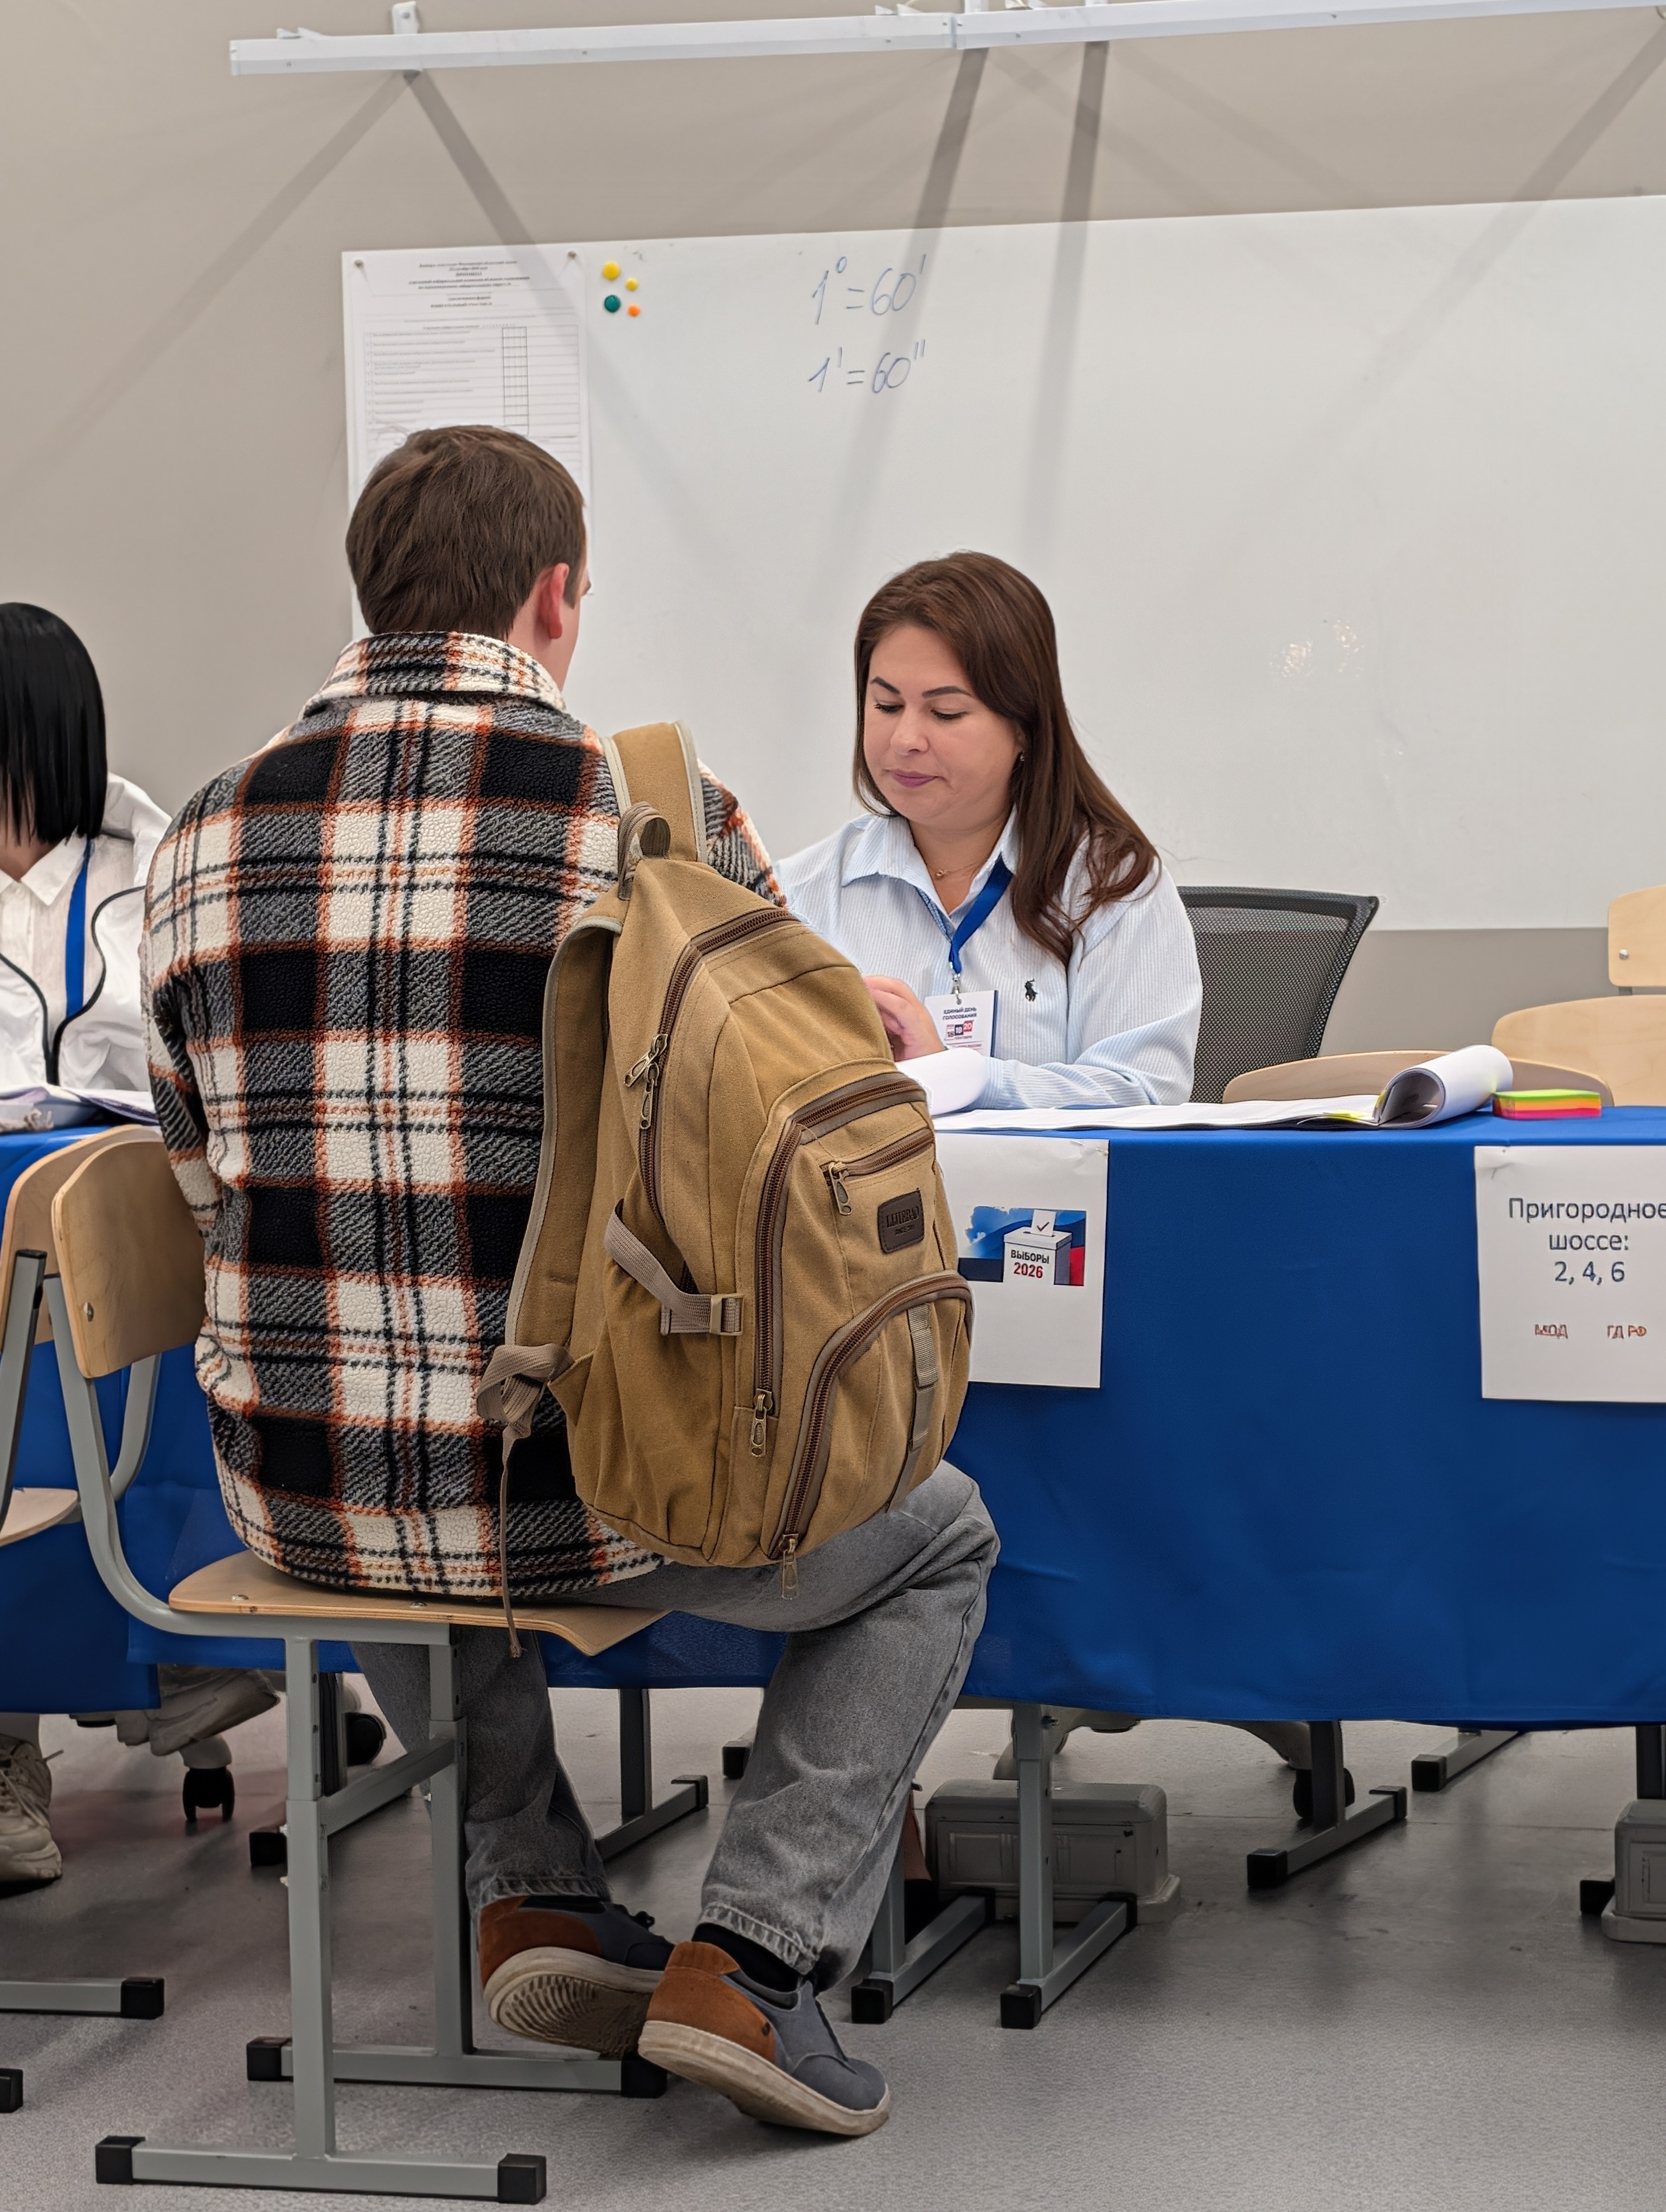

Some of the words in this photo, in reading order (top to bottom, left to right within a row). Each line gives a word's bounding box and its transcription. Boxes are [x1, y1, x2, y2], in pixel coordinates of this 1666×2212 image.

[964, 1022, 972, 1030] 20
[1508, 1198, 1666, 1224] Пригородное
[1549, 1234, 1629, 1250] шоссе:
[1011, 1249, 1049, 1264] ВЫБОРЫ
[1014, 1262, 1043, 1278] 2026
[1554, 1261, 1574, 1285] 2,
[1582, 1261, 1602, 1285] 4,
[1611, 1261, 1625, 1282] 6
[1607, 1325, 1624, 1339] ГД
[1628, 1325, 1647, 1337] РФ
